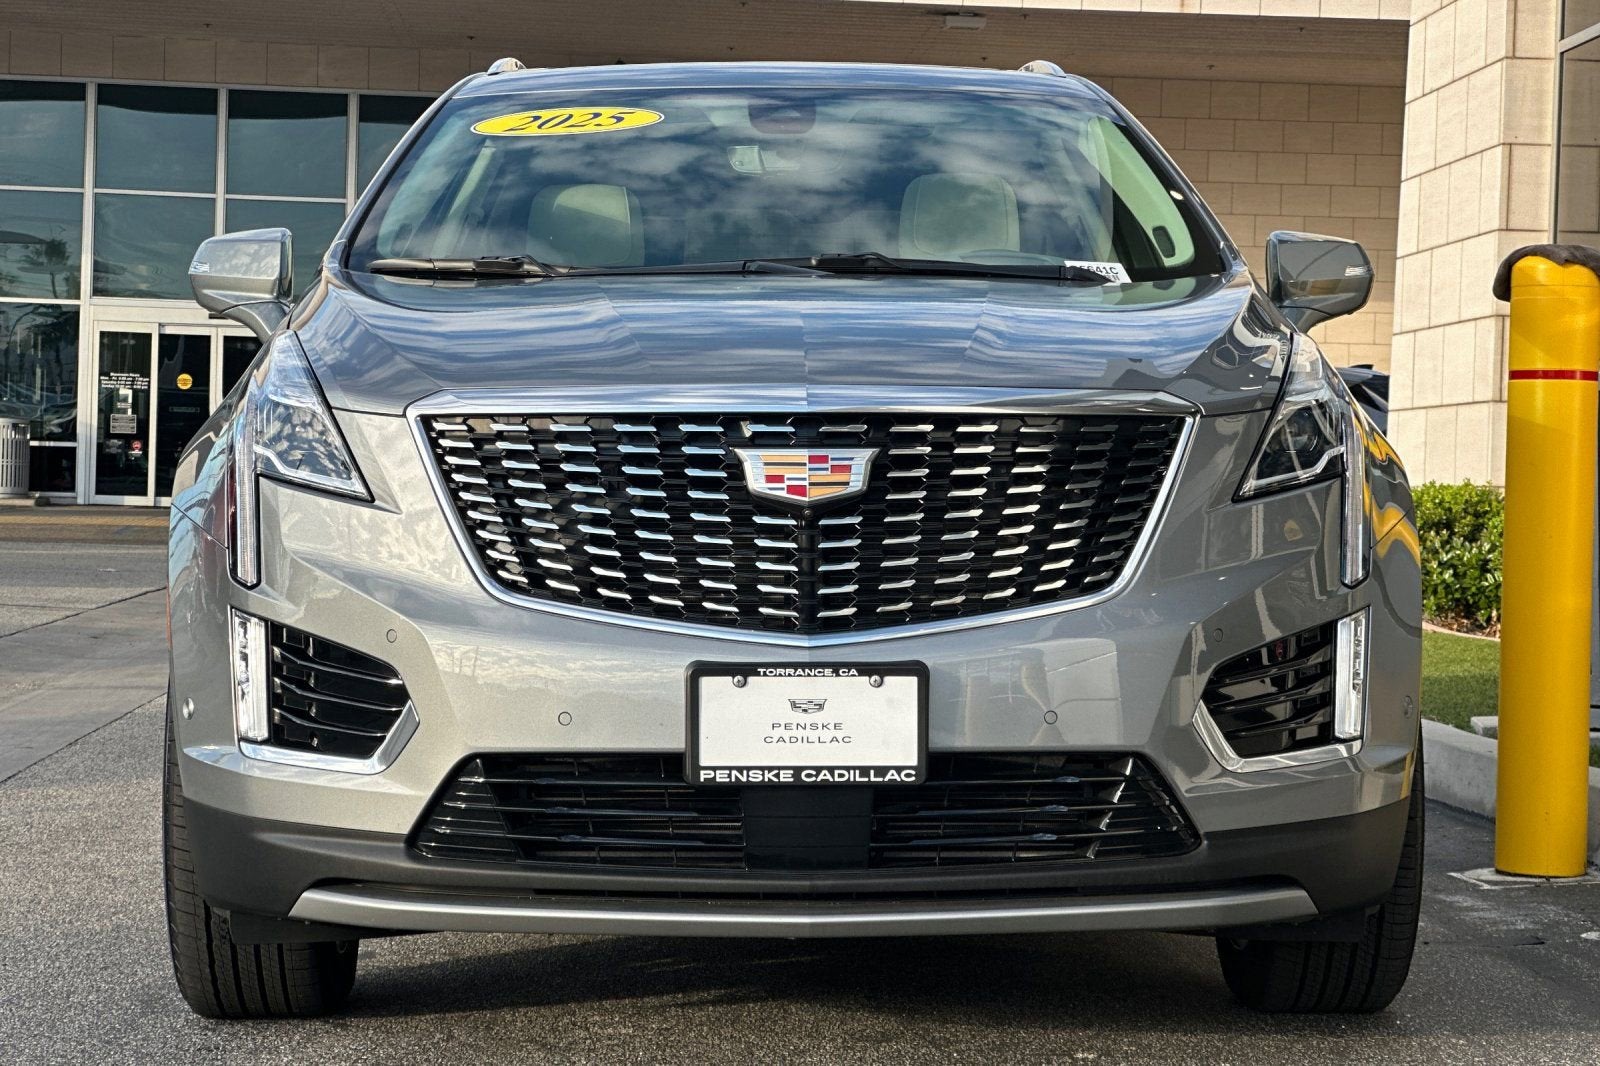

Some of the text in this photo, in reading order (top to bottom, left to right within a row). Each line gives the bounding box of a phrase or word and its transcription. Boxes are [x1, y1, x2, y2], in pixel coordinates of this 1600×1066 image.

[502, 111, 636, 132] 2025
[757, 668, 859, 677] TORRANCE, CA
[771, 722, 844, 731] PENSKE
[763, 735, 853, 744] CADILLAC
[700, 769, 916, 782] PENSKE CADILLAC
